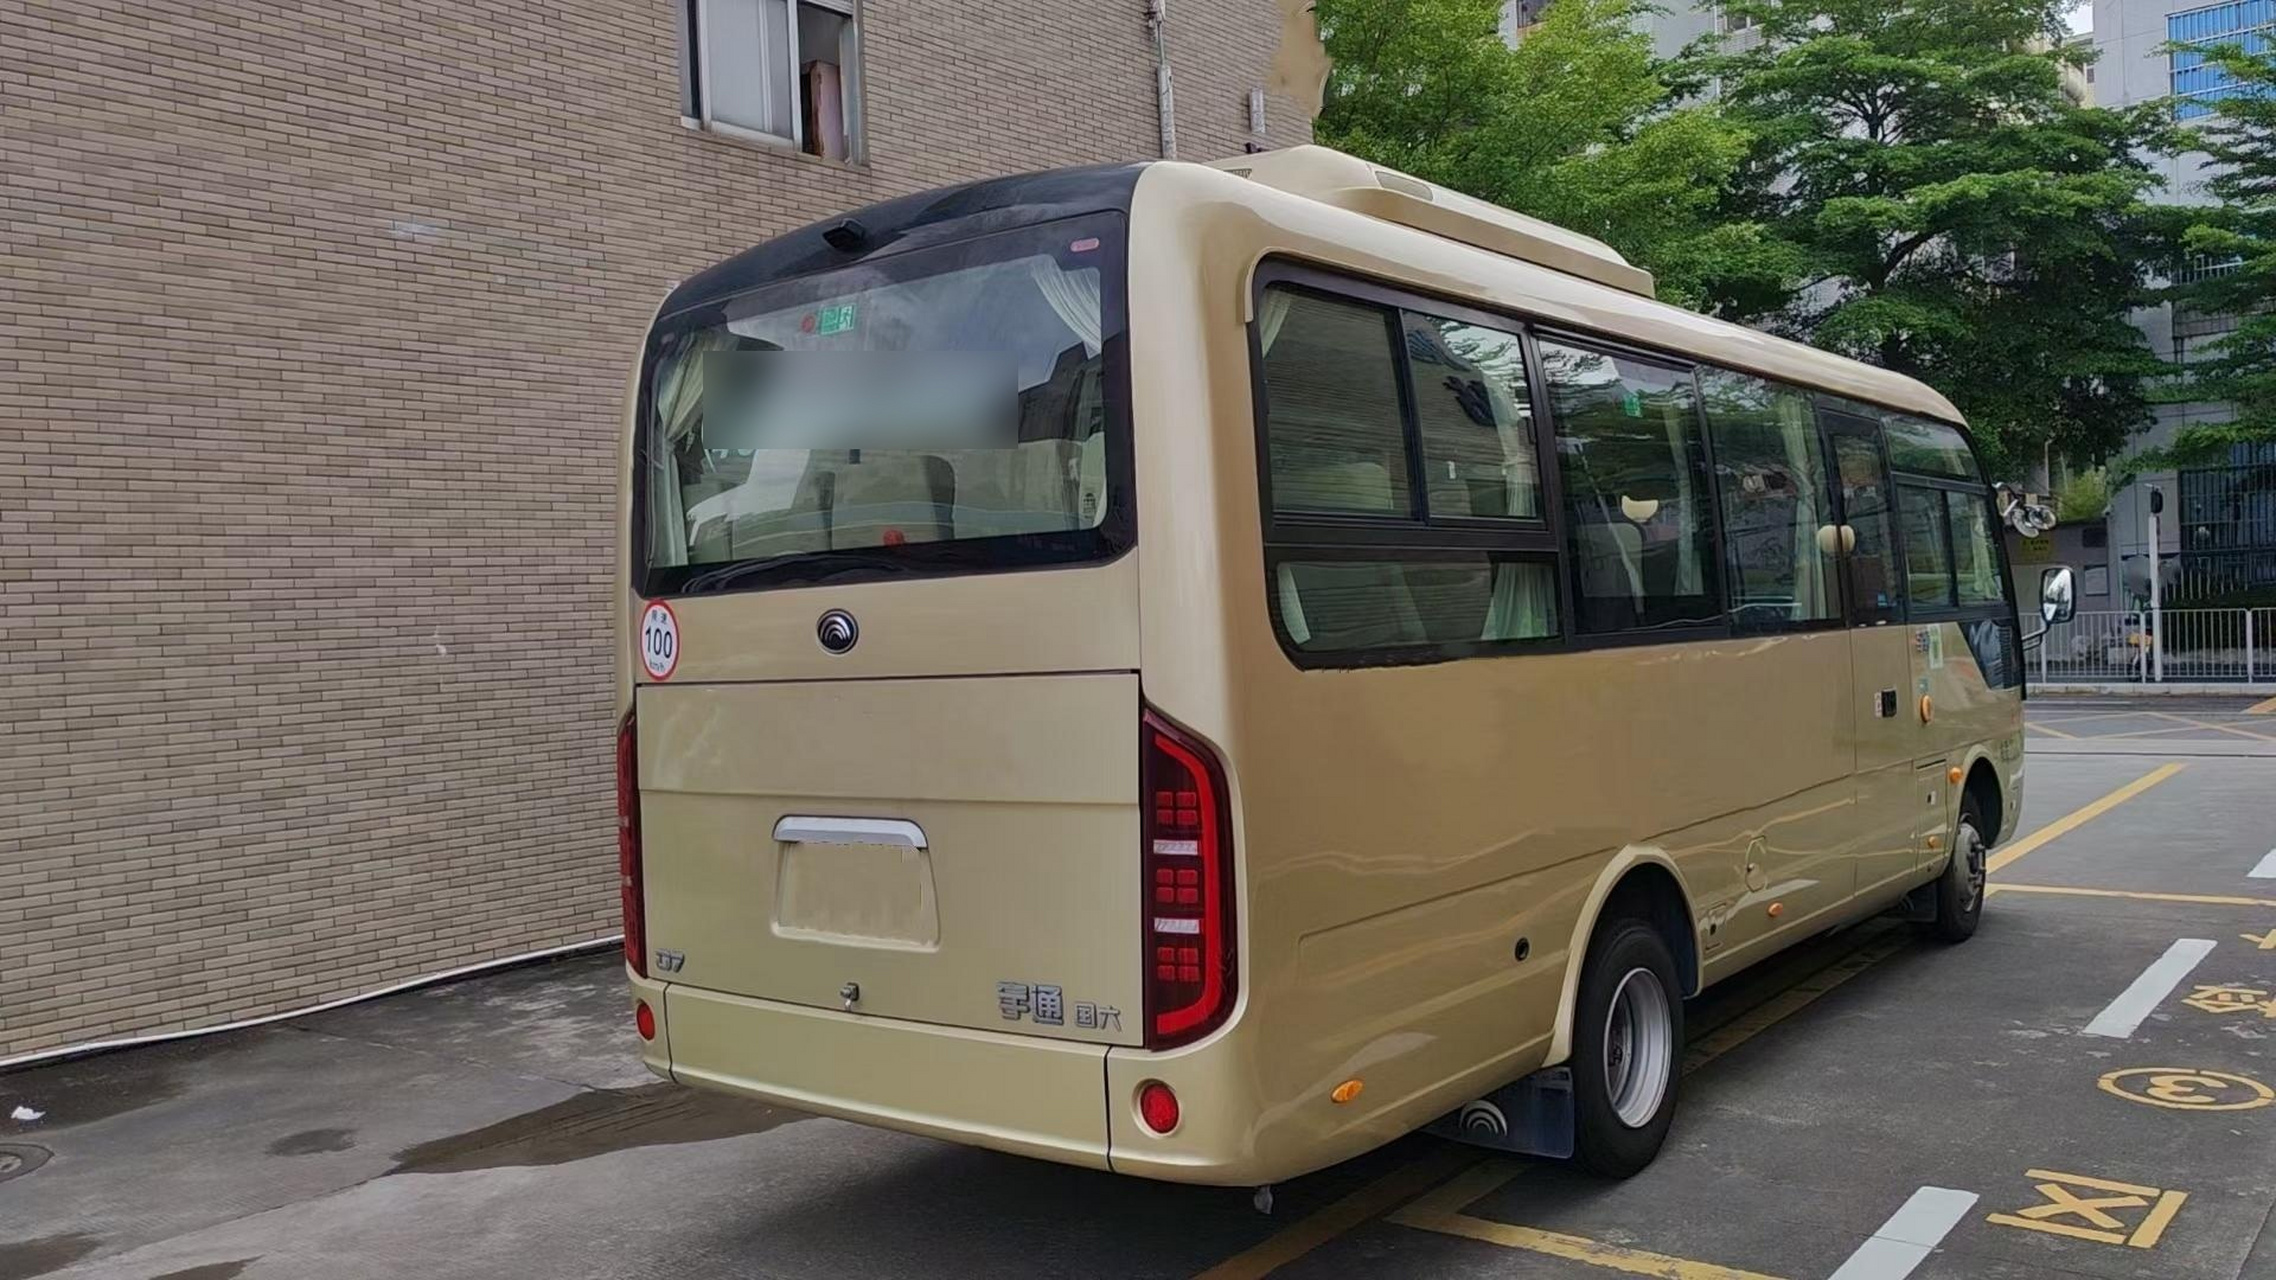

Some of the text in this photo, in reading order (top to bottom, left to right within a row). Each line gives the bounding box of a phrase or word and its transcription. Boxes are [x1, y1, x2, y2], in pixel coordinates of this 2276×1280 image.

[645, 626, 673, 659] 100
[997, 982, 1122, 1032] 宇通 国六
